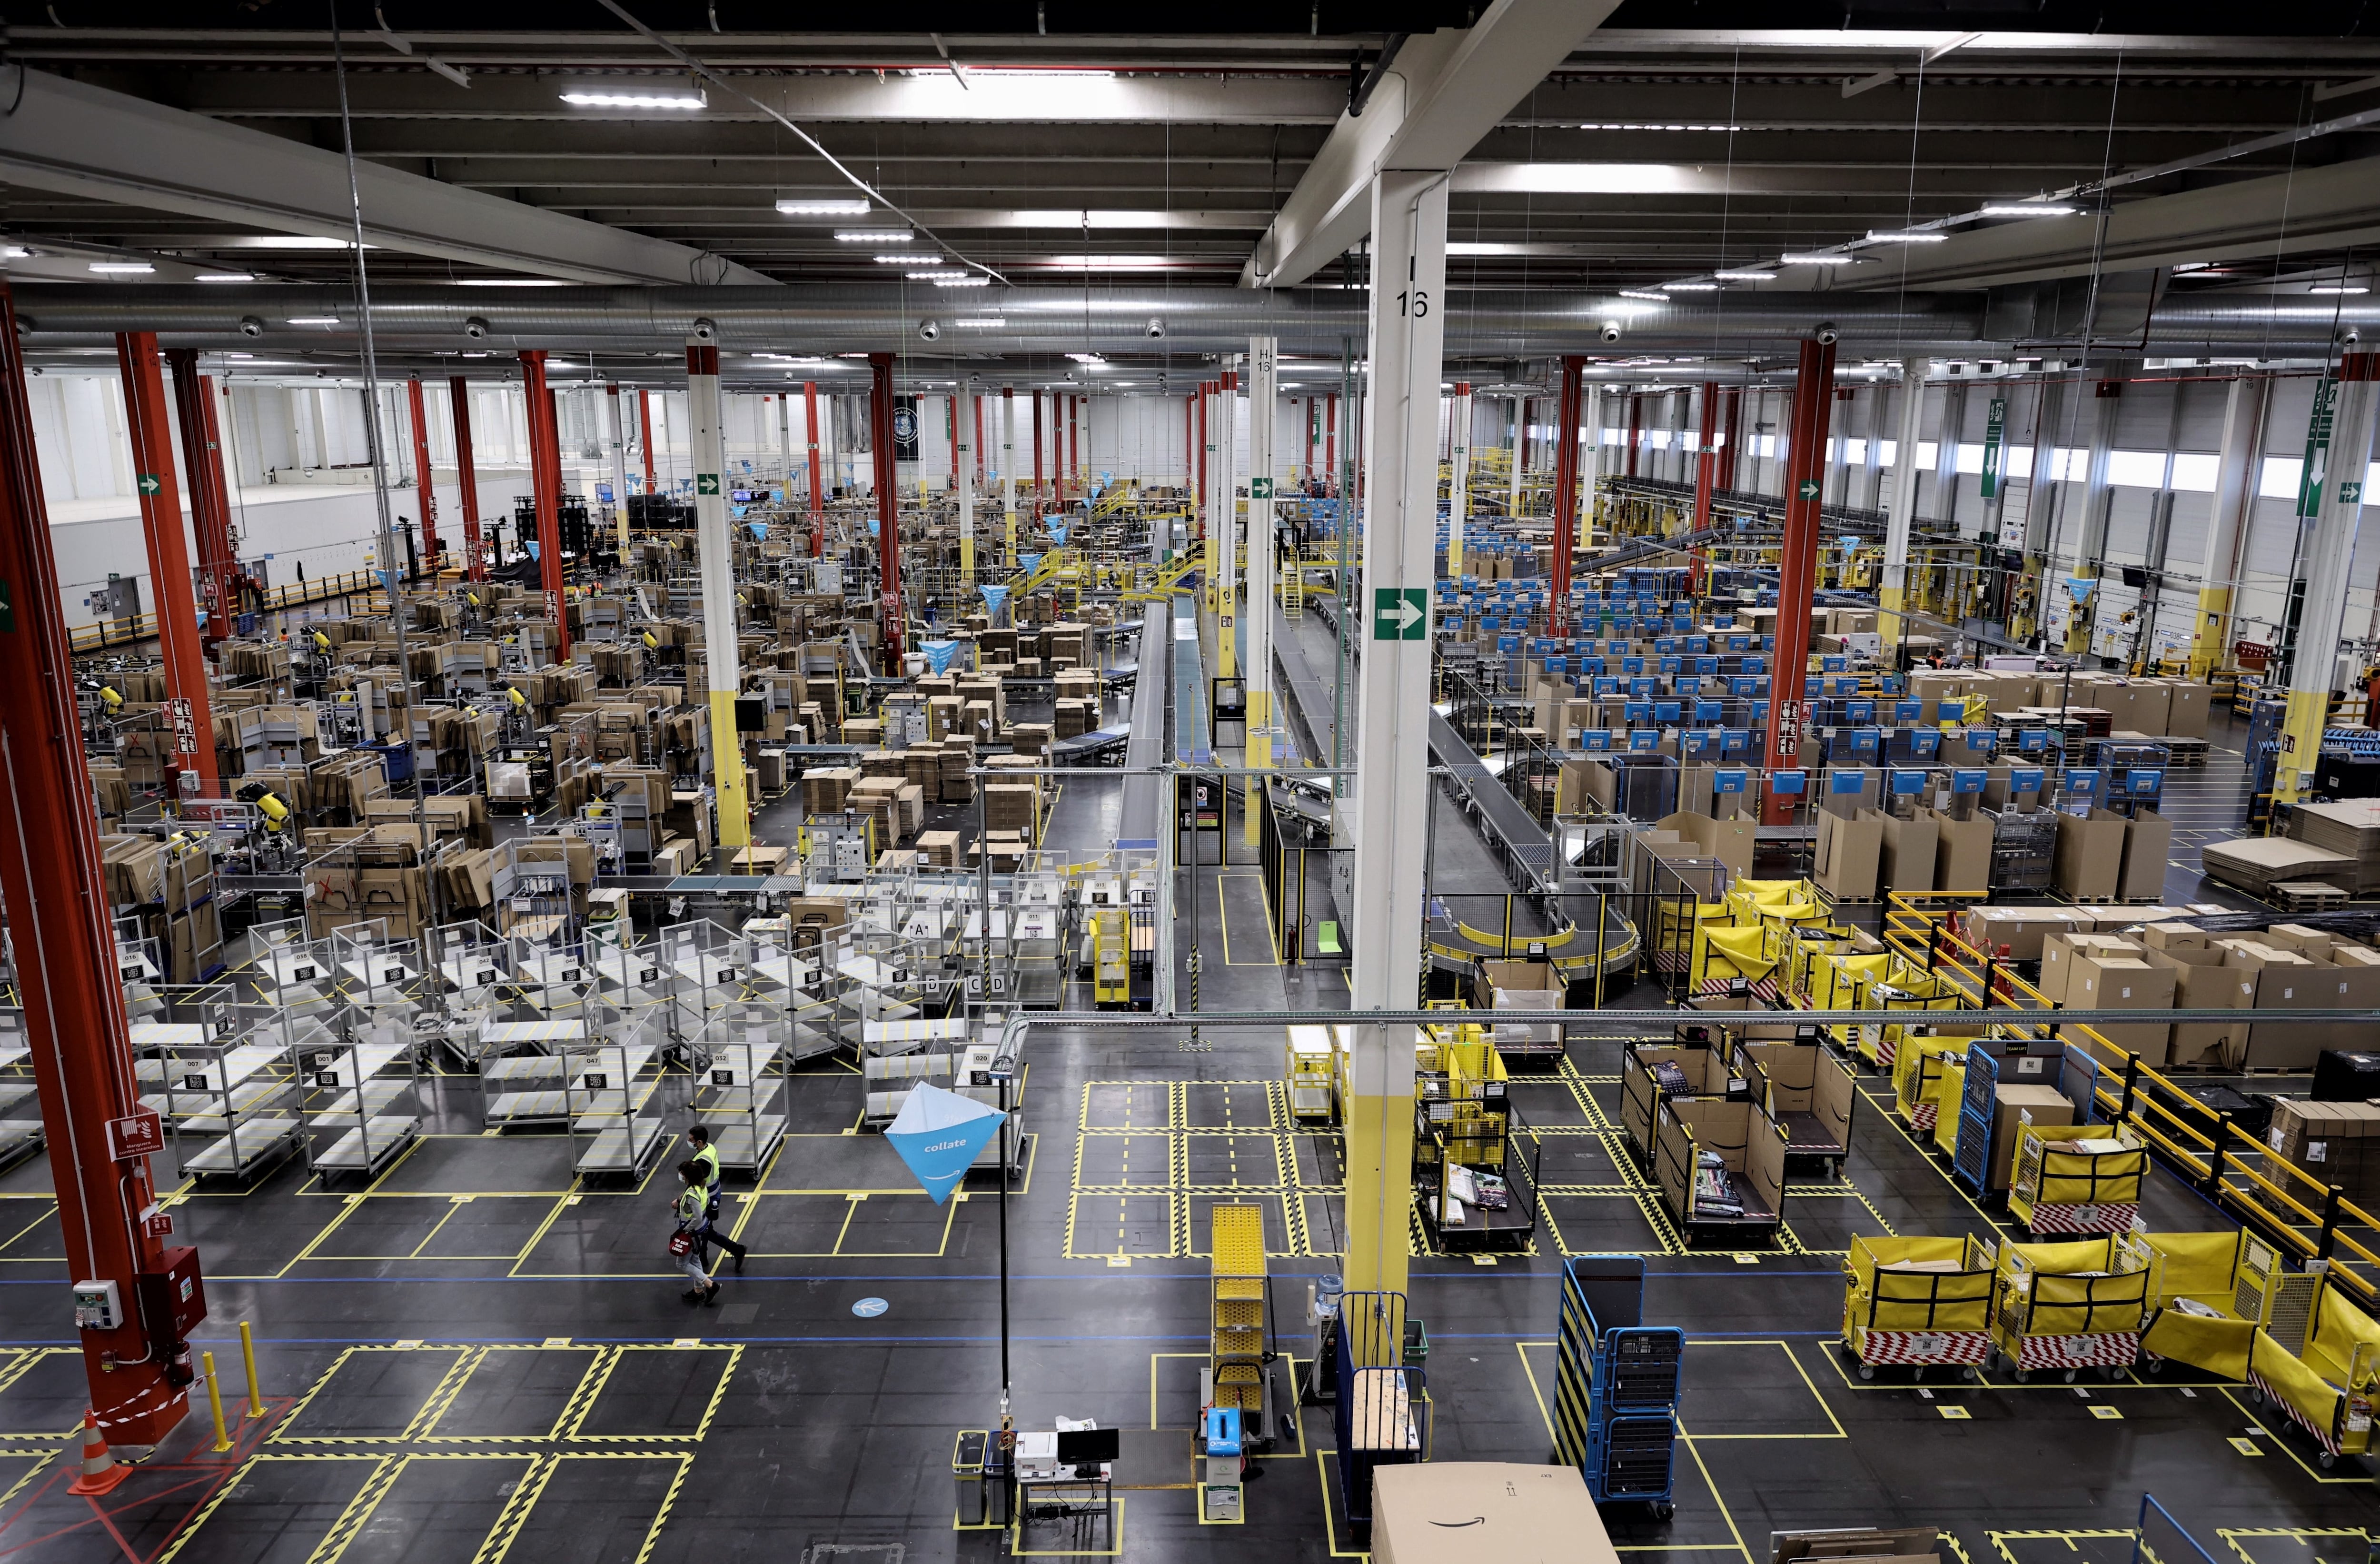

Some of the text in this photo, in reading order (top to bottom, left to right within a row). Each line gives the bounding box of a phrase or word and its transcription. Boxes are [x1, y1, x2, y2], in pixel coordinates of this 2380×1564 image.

[1397, 290, 1428, 317] 16
[1260, 349, 1268, 359] H
[1258, 362, 1269, 372] 16
[2170, 632, 2180, 640] 038
[915, 924, 923, 935] A
[929, 979, 937, 989] D
[972, 979, 979, 990] C
[994, 979, 1002, 989] D
[126, 1141, 151, 1149] Manguera
[136, 1144, 160, 1153] incendios
[924, 1137, 966, 1153] collate
